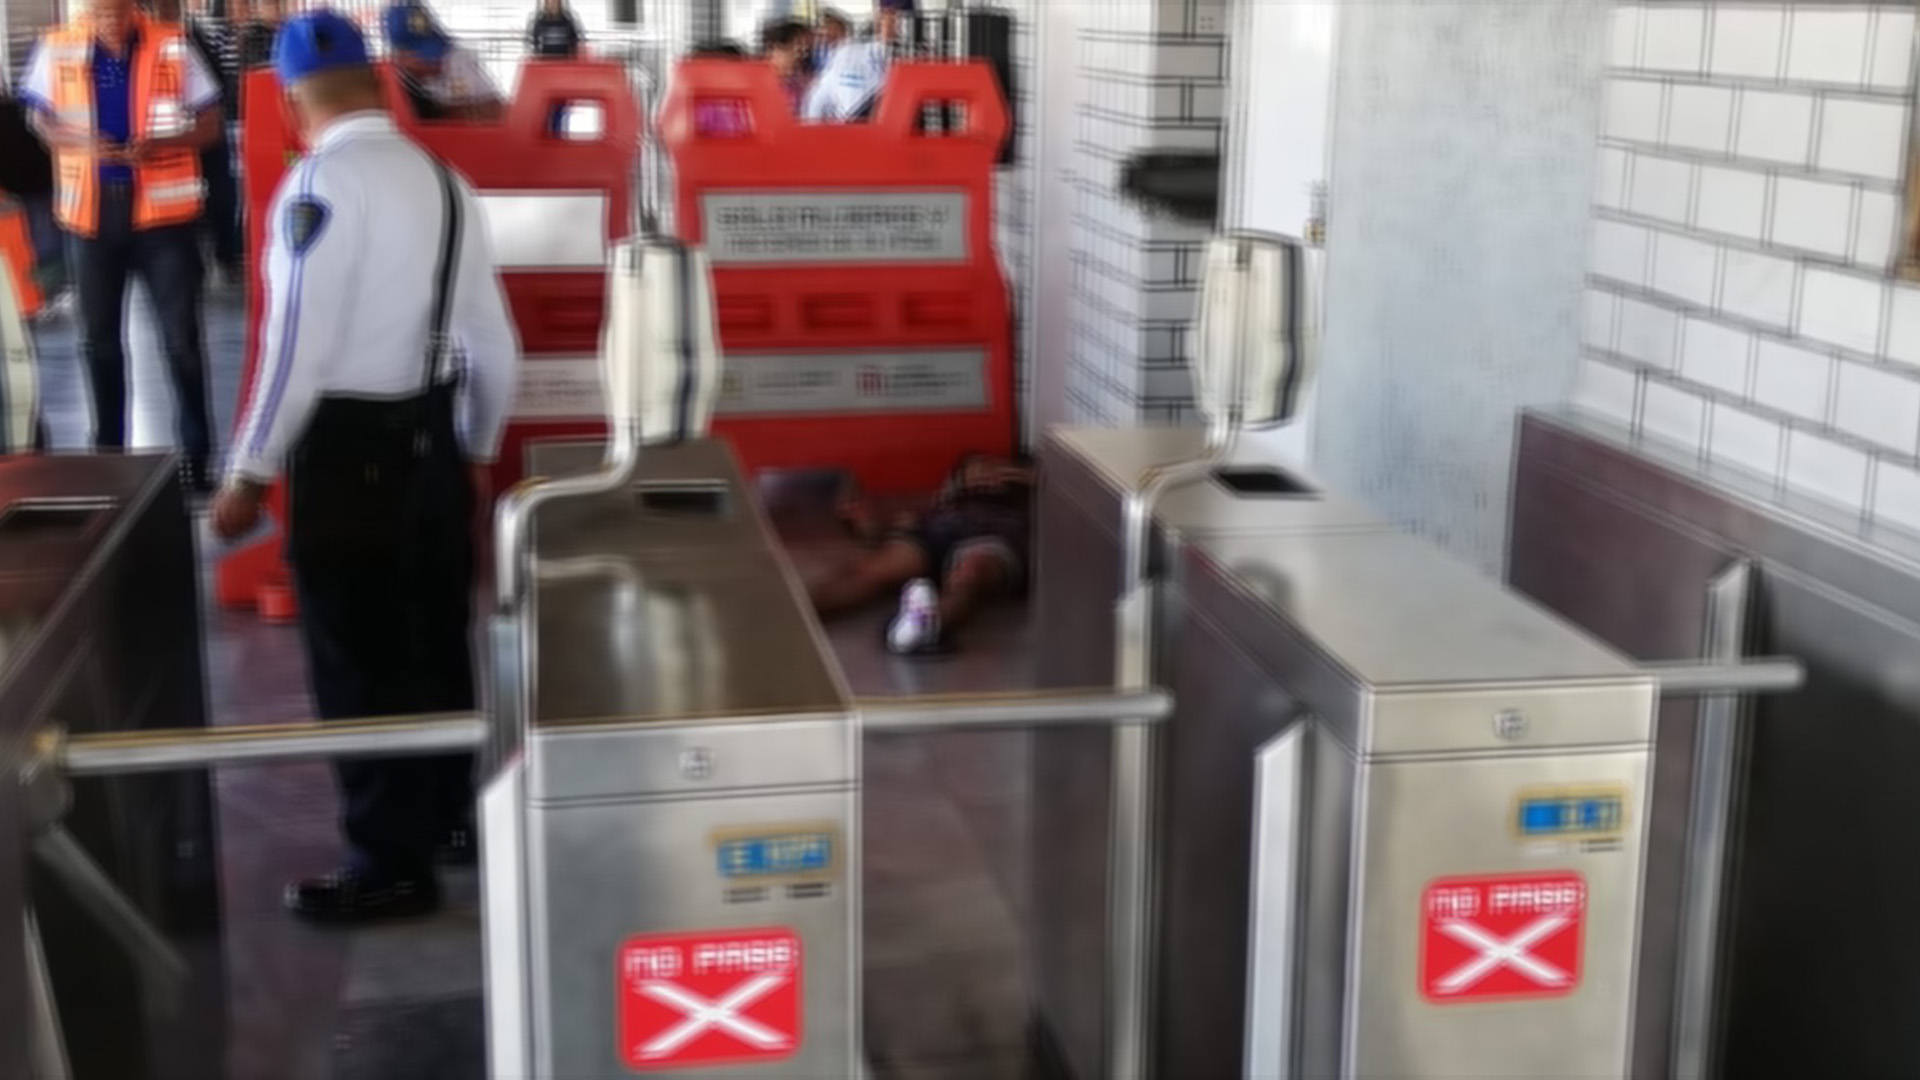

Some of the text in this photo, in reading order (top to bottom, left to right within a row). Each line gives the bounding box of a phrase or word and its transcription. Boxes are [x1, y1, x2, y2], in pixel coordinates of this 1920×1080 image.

[1431, 884, 1582, 916] NO PASE
[628, 941, 796, 977] NO PASE
